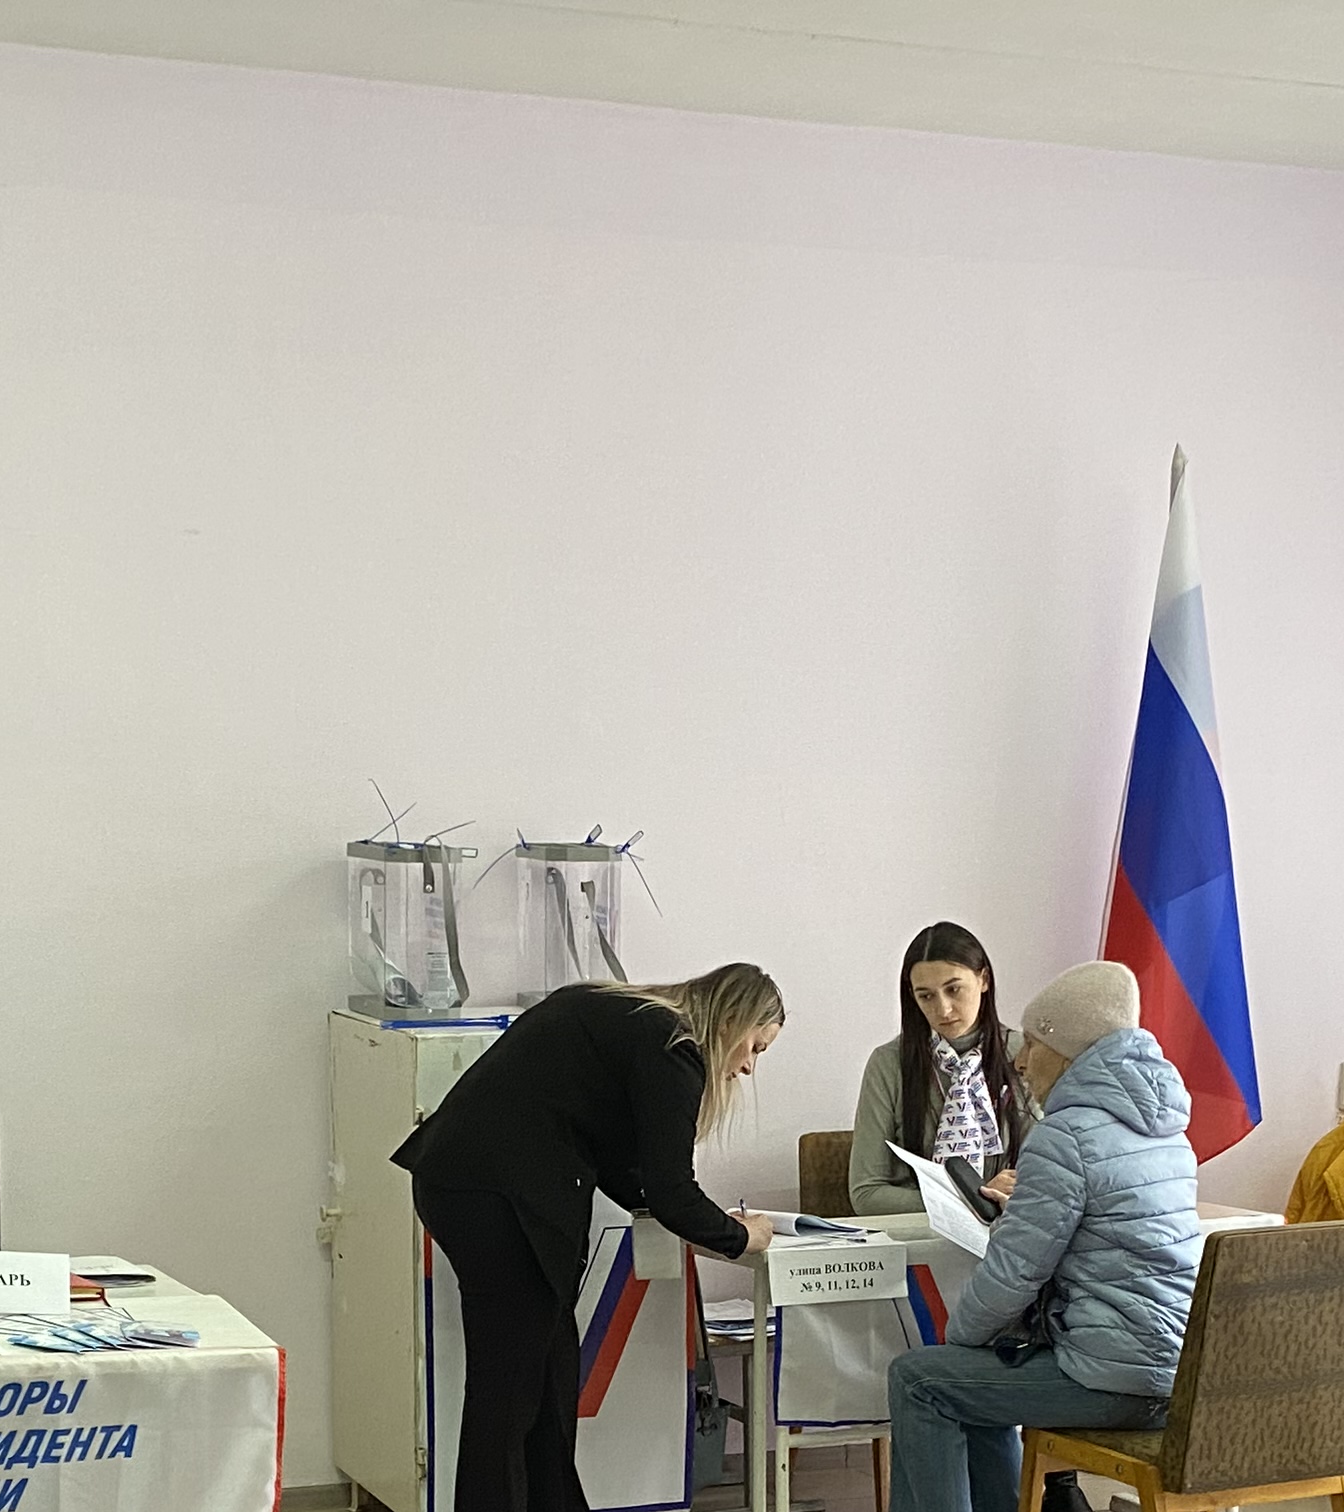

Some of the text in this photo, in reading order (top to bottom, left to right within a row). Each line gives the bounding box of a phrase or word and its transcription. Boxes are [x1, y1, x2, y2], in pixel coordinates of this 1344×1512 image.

[789, 1260, 885, 1279] улица ВОЛКОВА
[800, 1281, 814, 1293] №
[845, 1279, 860, 1290] 12,
[863, 1277, 874, 1288] 14
